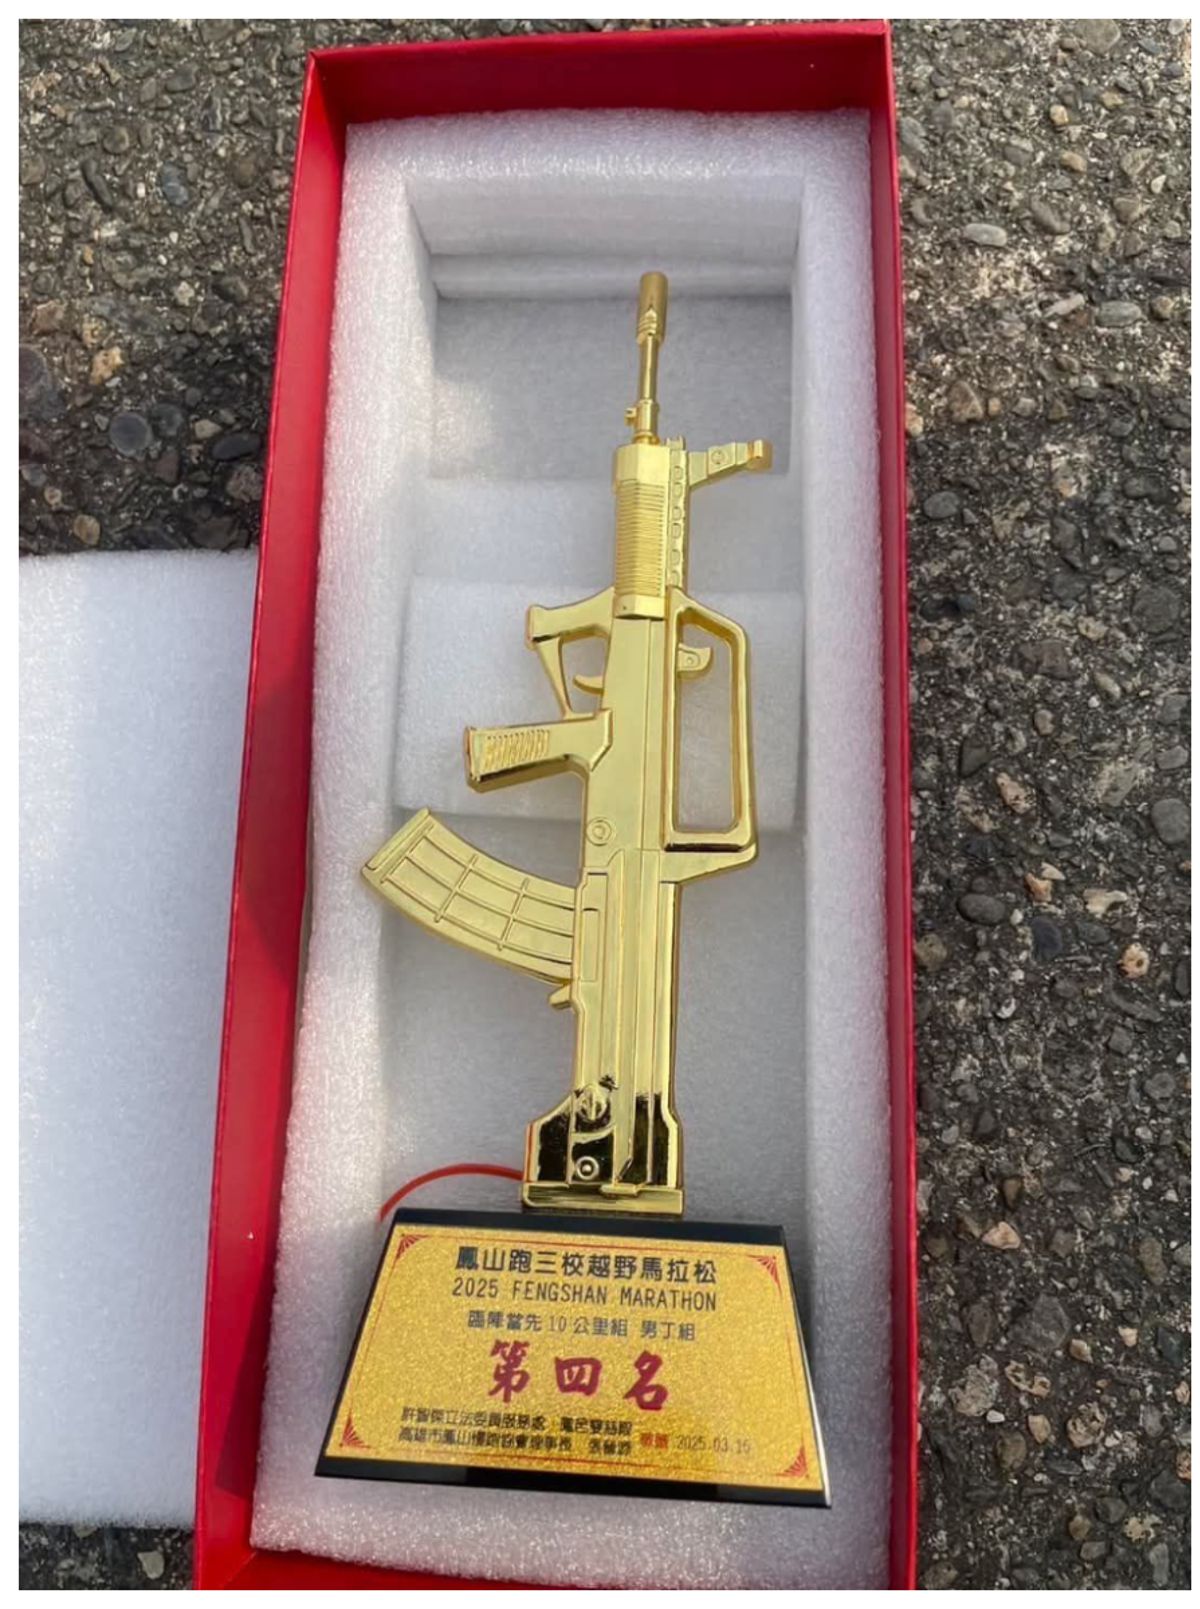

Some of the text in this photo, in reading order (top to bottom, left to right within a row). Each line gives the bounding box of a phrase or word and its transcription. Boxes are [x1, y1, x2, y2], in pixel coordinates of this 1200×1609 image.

[455, 1246, 717, 1284] 鳳山跑三校越野馬拉松
[452, 1277, 717, 1311] 2025 FENGSHAN MARATHON
[487, 1339, 669, 1411] 第四名
